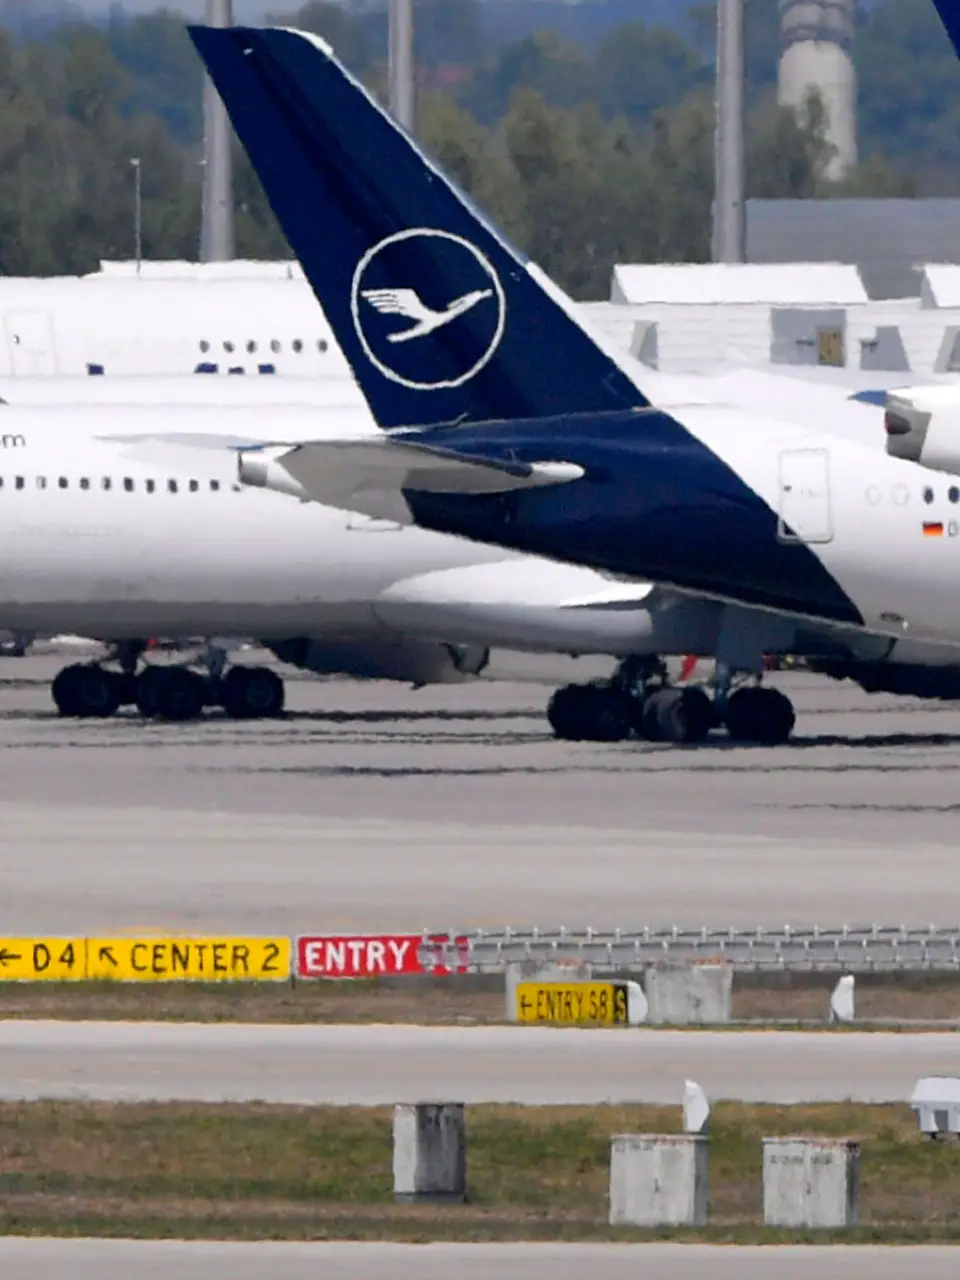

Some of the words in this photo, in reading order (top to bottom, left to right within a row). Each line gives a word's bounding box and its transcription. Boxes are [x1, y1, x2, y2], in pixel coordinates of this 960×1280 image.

[0, 434, 26, 448] m
[33, 943, 75, 971] D4
[130, 943, 249, 973] CENTER
[261, 942, 279, 971] 2
[305, 940, 410, 971] ENTRY
[536, 990, 584, 1020] ENTRY
